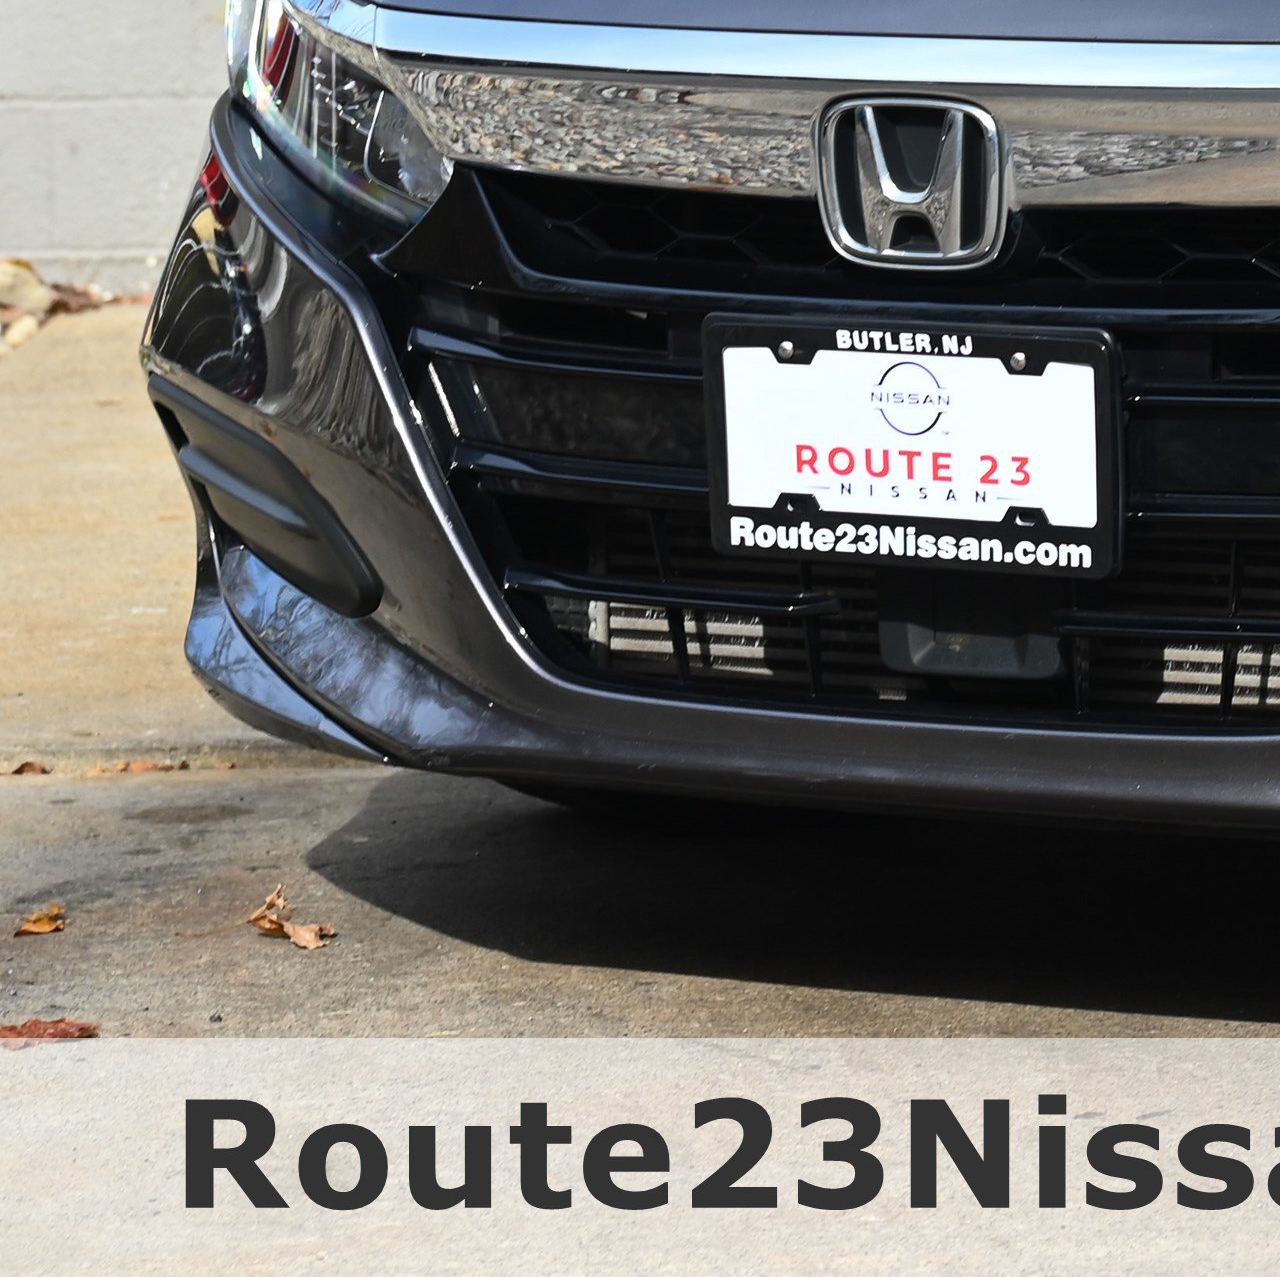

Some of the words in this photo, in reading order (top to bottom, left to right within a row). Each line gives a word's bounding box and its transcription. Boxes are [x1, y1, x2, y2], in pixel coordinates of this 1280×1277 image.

[870, 390, 950, 408] NISSAN
[796, 444, 953, 483] ROUTE
[979, 454, 1031, 487] 23
[840, 482, 987, 504] NISSAN
[730, 516, 1092, 569] Route23Nissan.com
